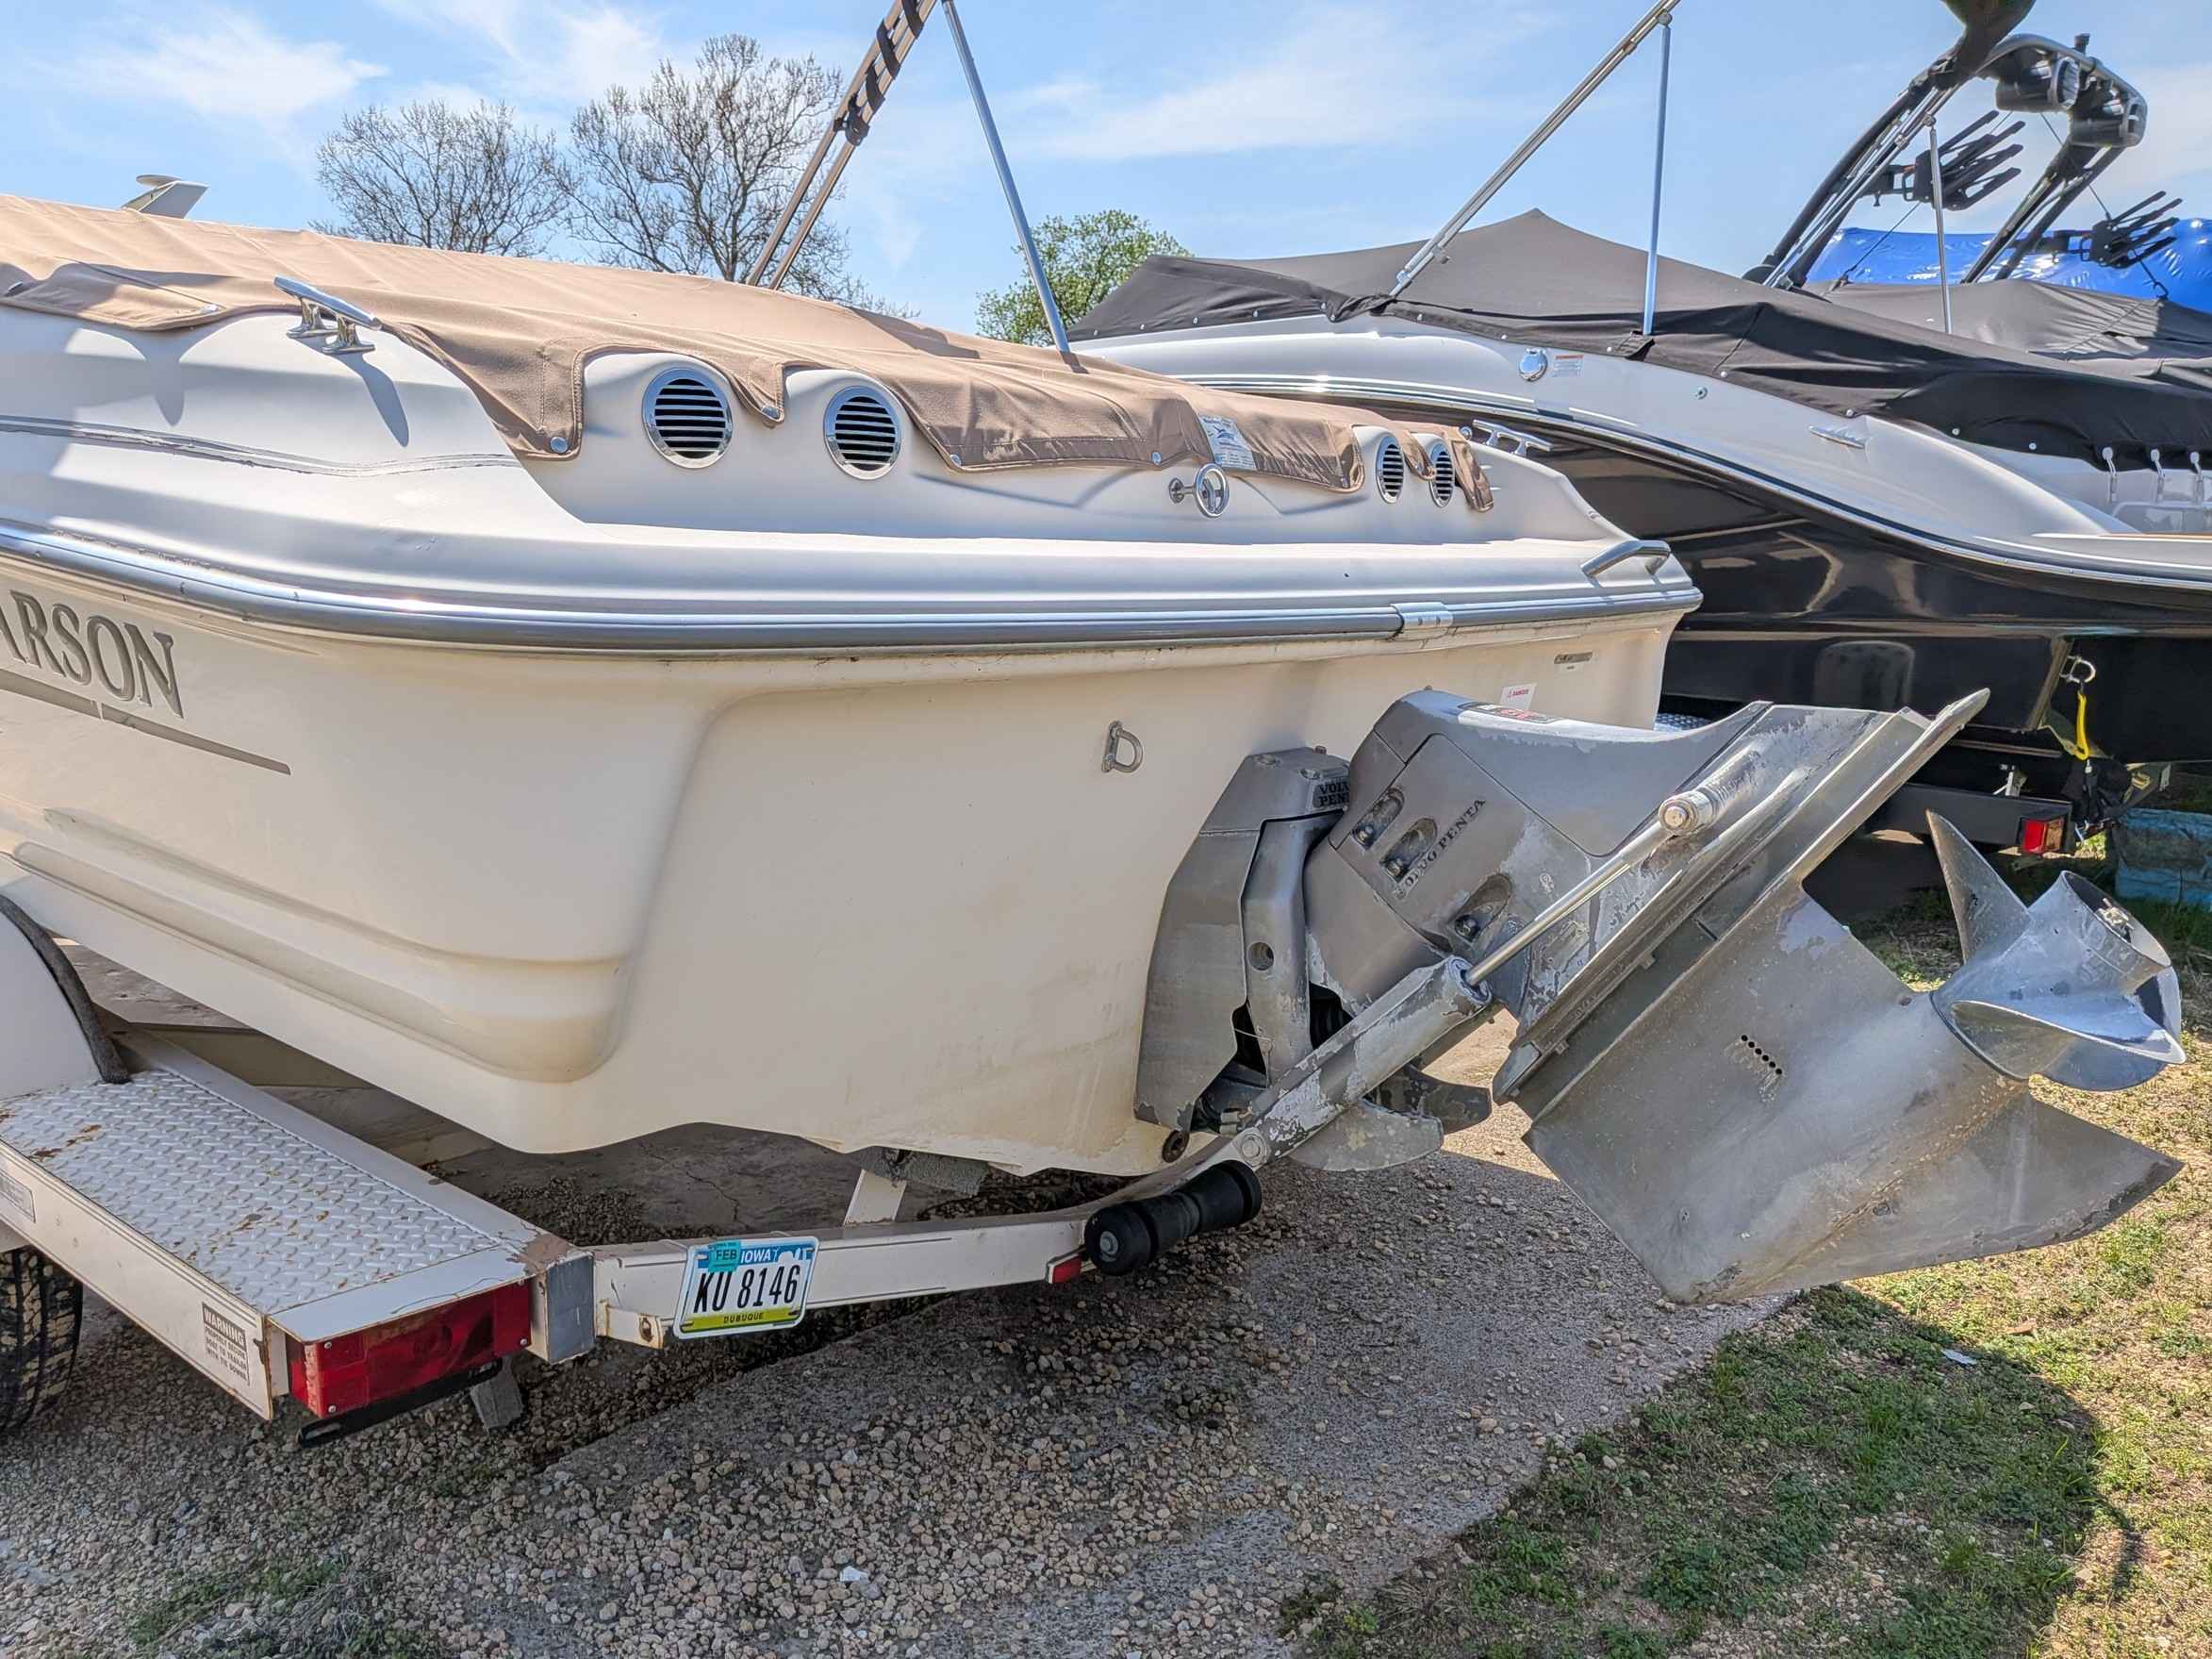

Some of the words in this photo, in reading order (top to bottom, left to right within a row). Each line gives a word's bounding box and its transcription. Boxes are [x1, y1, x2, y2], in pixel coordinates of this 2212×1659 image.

[1438, 799, 1486, 850] PENTA
[716, 1249, 737, 1261] FEB
[740, 1249, 771, 1264] IOWA
[693, 1270, 733, 1314] KU
[736, 1265, 801, 1309] 8146
[723, 1312, 764, 1324] DUBUQUE
[204, 1307, 244, 1346] WARNING
[219, 1346, 226, 1357] TO
